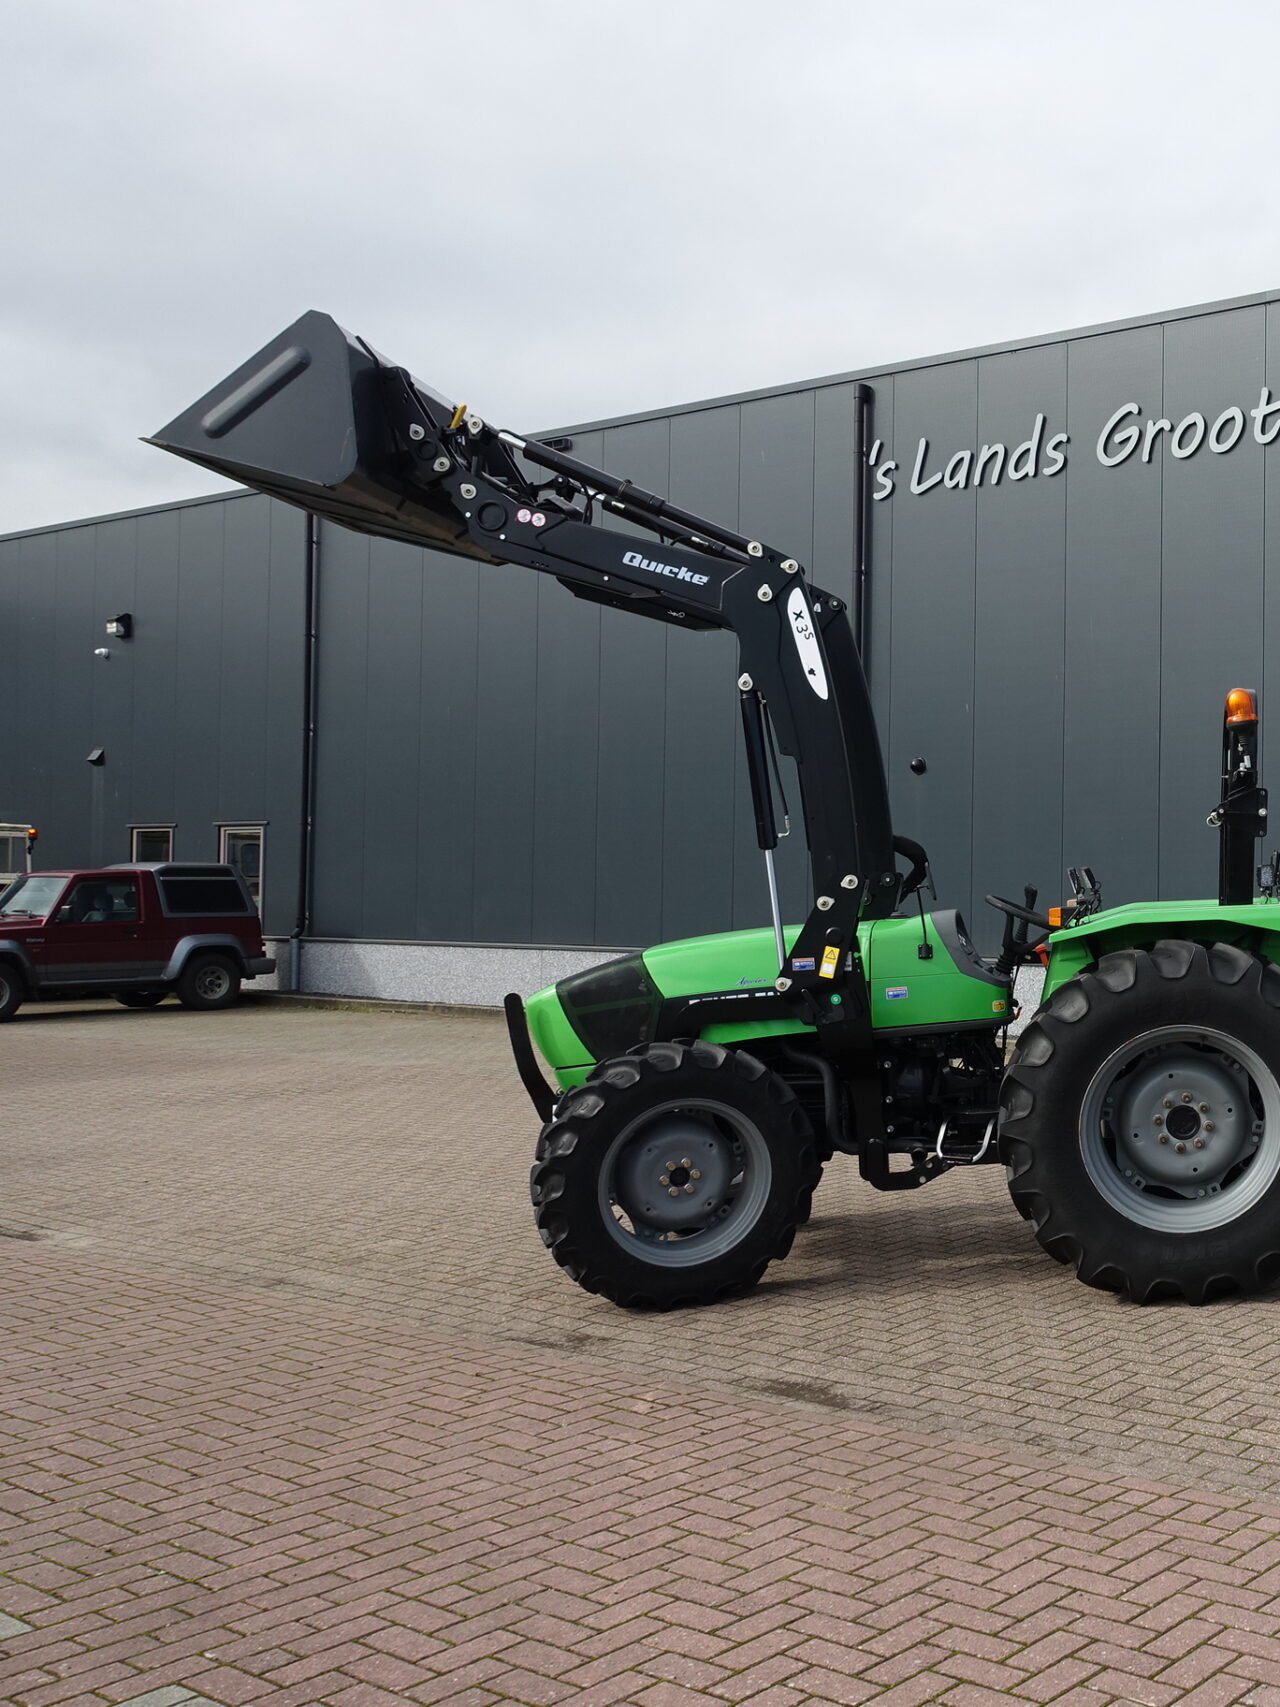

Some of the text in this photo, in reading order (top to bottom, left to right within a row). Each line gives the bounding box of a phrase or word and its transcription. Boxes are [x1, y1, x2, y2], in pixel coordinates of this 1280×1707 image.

[867, 439, 897, 501] 's
[909, 412, 1069, 496] Lands
[622, 551, 709, 586] Quicke
